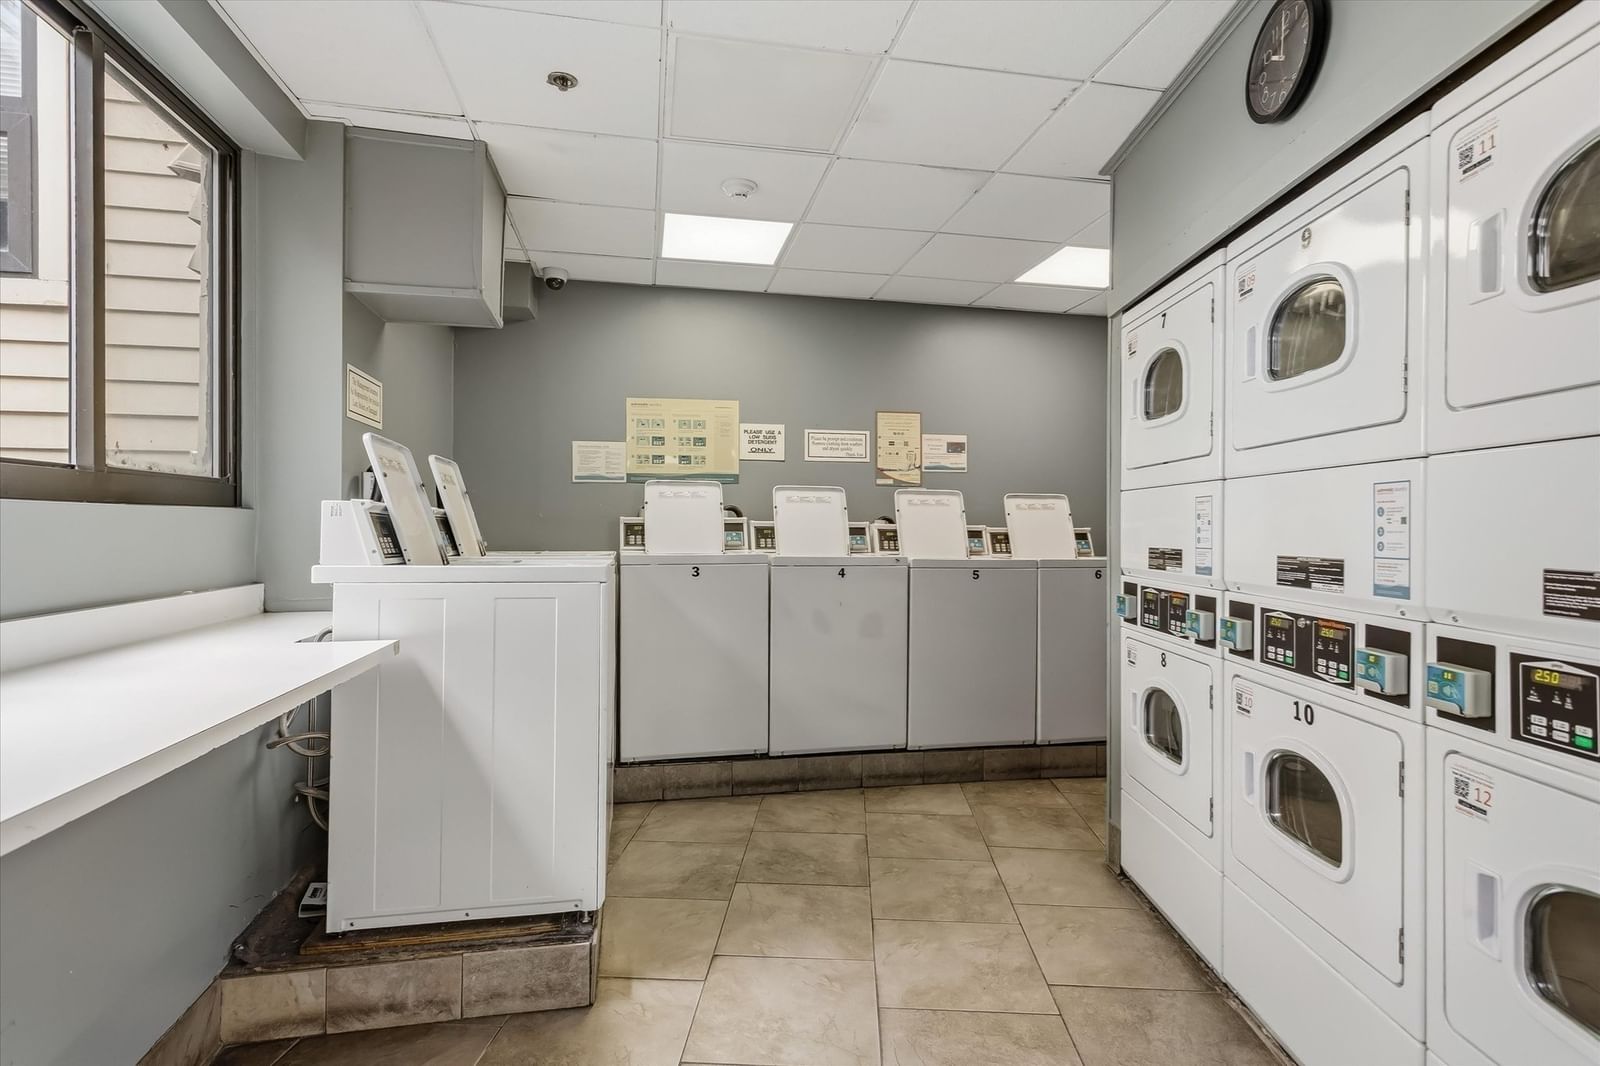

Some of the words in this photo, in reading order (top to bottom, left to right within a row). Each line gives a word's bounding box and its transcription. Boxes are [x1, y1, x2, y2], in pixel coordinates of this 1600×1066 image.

[1301, 227, 1312, 249] 9
[691, 566, 700, 577] 3
[838, 568, 846, 578] 4
[972, 570, 980, 580] 5
[1094, 570, 1102, 580] 6
[1160, 652, 1167, 668] 8
[1293, 700, 1315, 725] 10
[1474, 787, 1493, 807] 12
